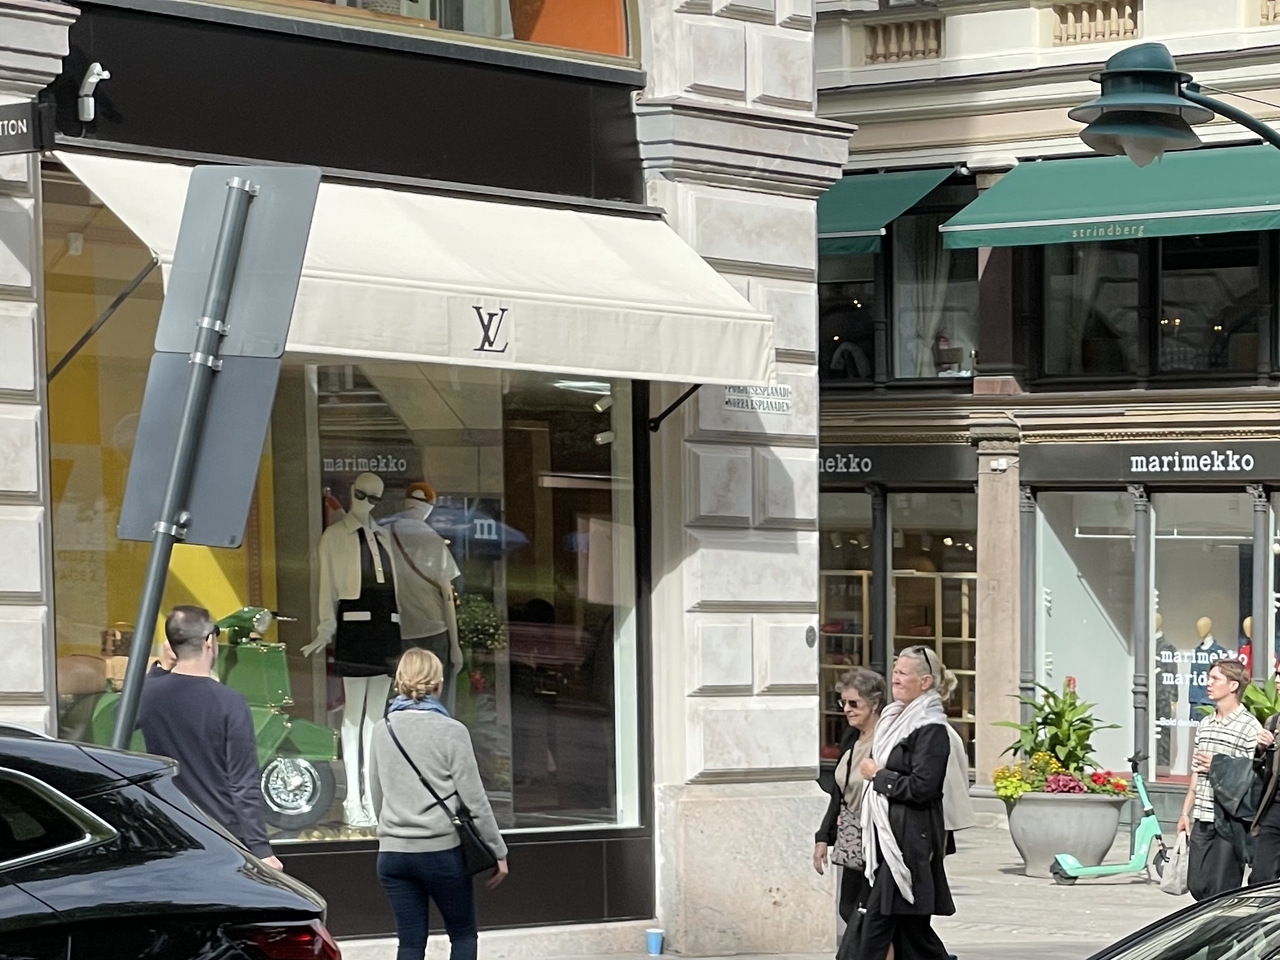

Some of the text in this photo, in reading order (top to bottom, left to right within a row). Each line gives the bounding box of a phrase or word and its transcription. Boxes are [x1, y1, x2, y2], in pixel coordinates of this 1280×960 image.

[1072, 224, 1145, 238] strindberg
[323, 454, 408, 472] marimekko
[1130, 450, 1254, 472] marimekko
